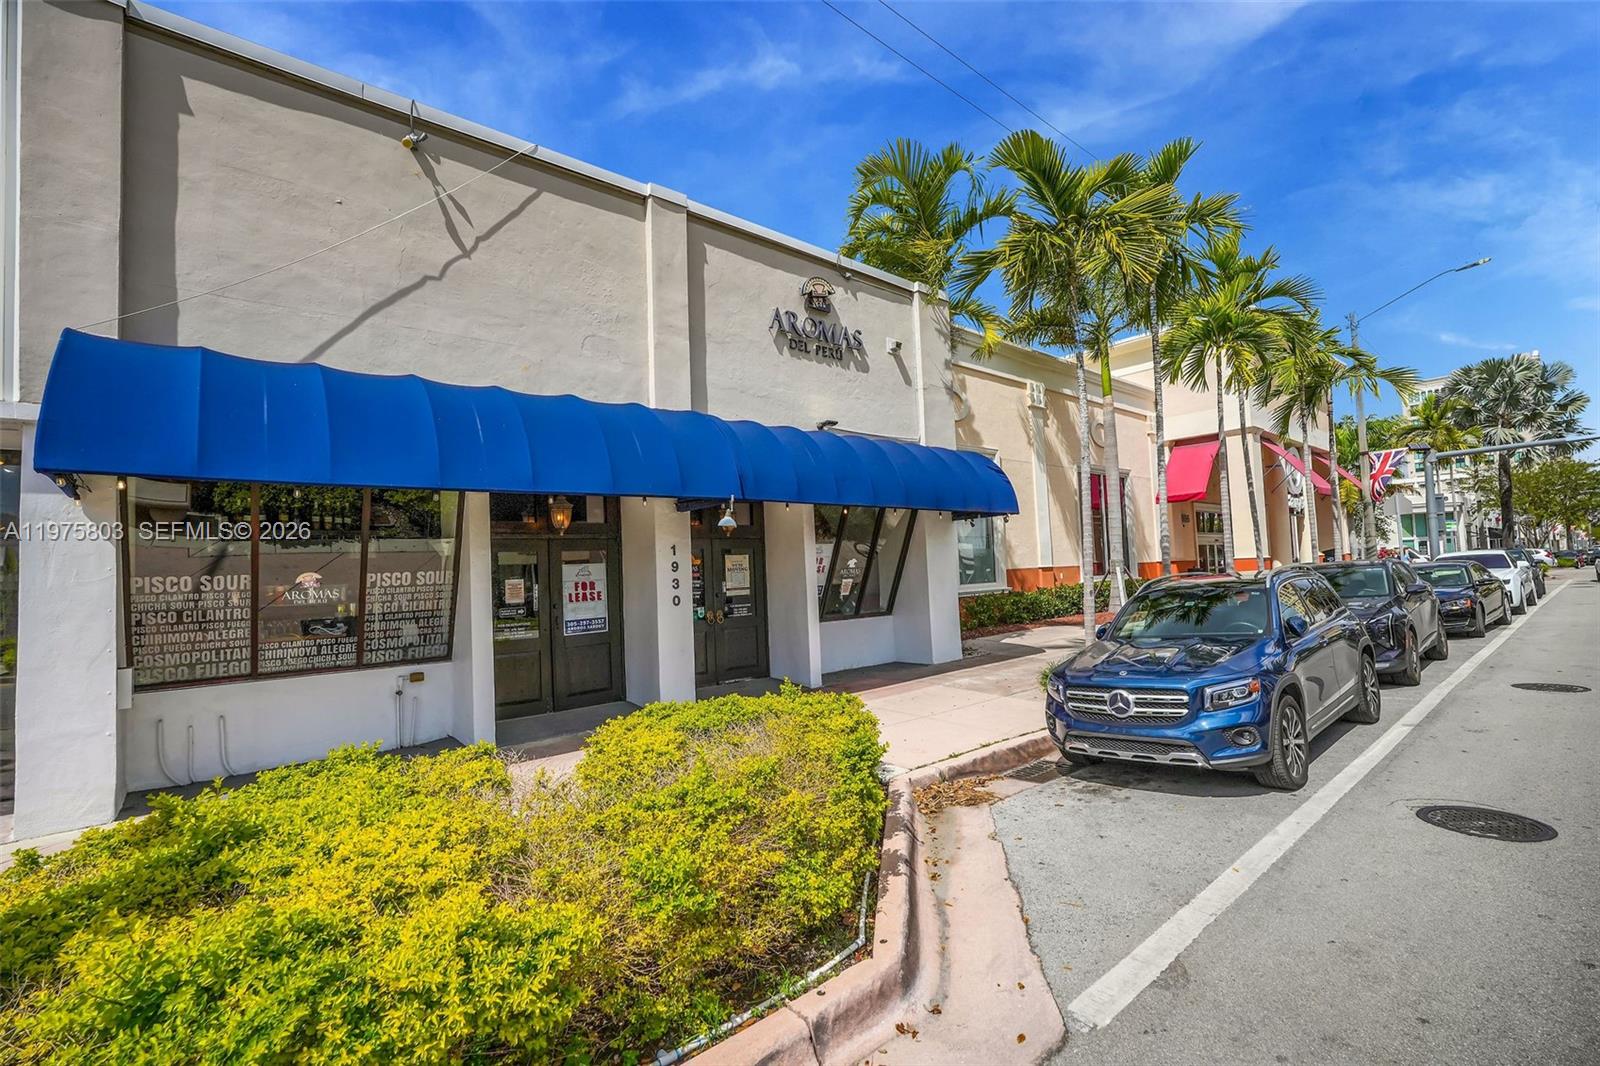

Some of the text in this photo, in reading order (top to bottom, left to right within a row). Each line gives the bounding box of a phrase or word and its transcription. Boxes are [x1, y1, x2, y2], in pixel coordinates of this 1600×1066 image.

[768, 307, 862, 350] AROMAS
[789, 338, 811, 354] DEL
[131, 574, 251, 594] PISCO SOUR
[366, 570, 454, 587] PISCO SOUR
[574, 581, 596, 591] FOR
[159, 592, 200, 602] CILANTRO
[201, 592, 225, 600] PISCO
[281, 588, 340, 601] AROMAS
[386, 586, 416, 594] CILANTRO
[416, 585, 433, 593] PISCO
[393, 593, 412, 601] SOUR
[413, 592, 434, 600] PISCO
[568, 591, 602, 603] LEASE
[131, 599, 251, 612] CHICHA SOUR PISCO SOUR
[365, 600, 399, 614] PISCO
[131, 608, 251, 626] PISCO CILANTRO
[384, 612, 414, 620] CILANTRO
[414, 610, 432, 618] PISCO
[131, 620, 251, 635] PISCO CILANTRO PISCO FUEGO
[364, 631, 385, 639] PISCO
[131, 628, 251, 646] CHIRIMOYA ALEGRE
[258, 636, 357, 650] PISCO CILANTRO PISCO FUEGO
[363, 633, 449, 651] COSMOPOLITAN
[132, 639, 251, 655] PISCO FUEGO CHICHA SOUR
[258, 643, 357, 660] CHIRIMOYA ALEGRE
[363, 644, 449, 664] PISCO FUEGO
[132, 647, 251, 669] COSMOPOLITAN
[308, 654, 337, 664] CHICHA
[134, 660, 251, 685] PISCO FUEGO
